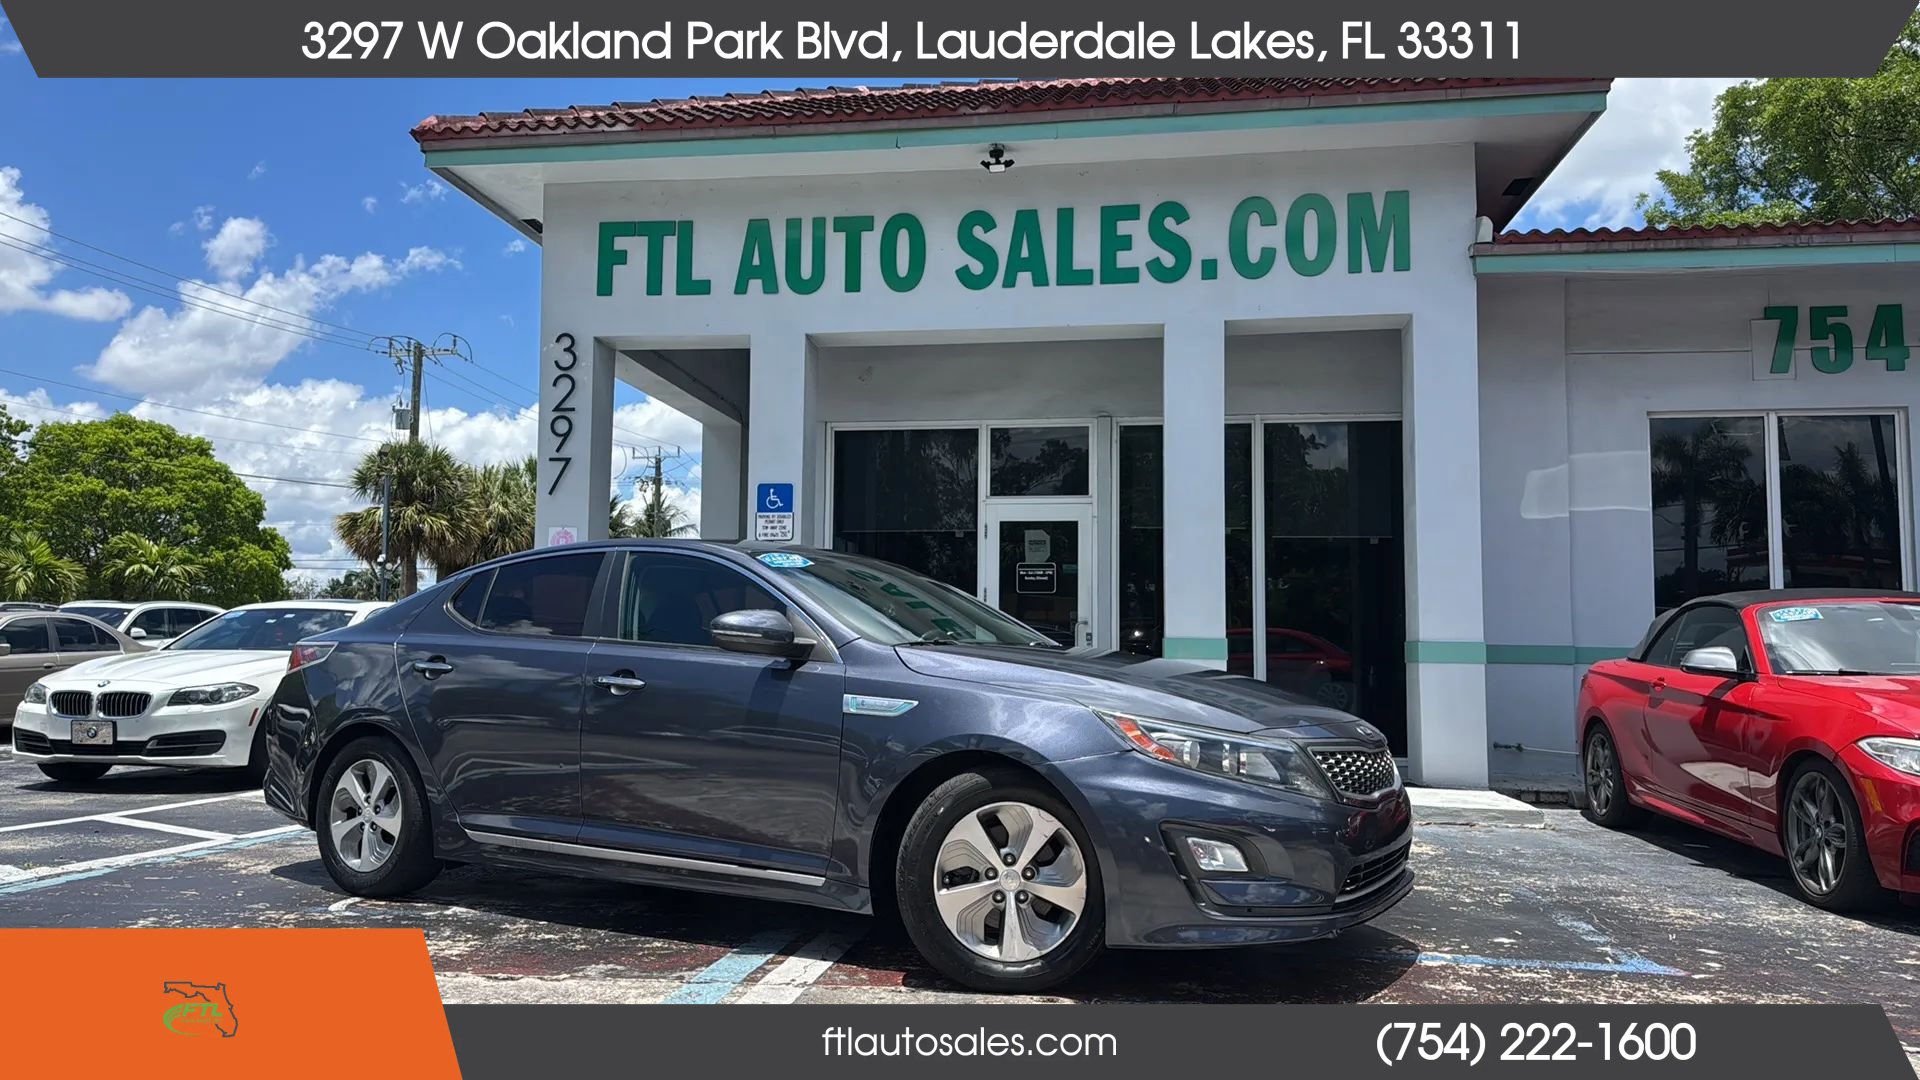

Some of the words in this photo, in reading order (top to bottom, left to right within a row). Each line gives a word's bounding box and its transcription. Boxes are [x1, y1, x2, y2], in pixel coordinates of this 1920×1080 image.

[596, 220, 711, 297] FTL
[734, 213, 927, 295] AUTO
[954, 190, 1412, 291] SALES.COM
[1764, 304, 1910, 376] 754
[548, 332, 577, 496] 3297
